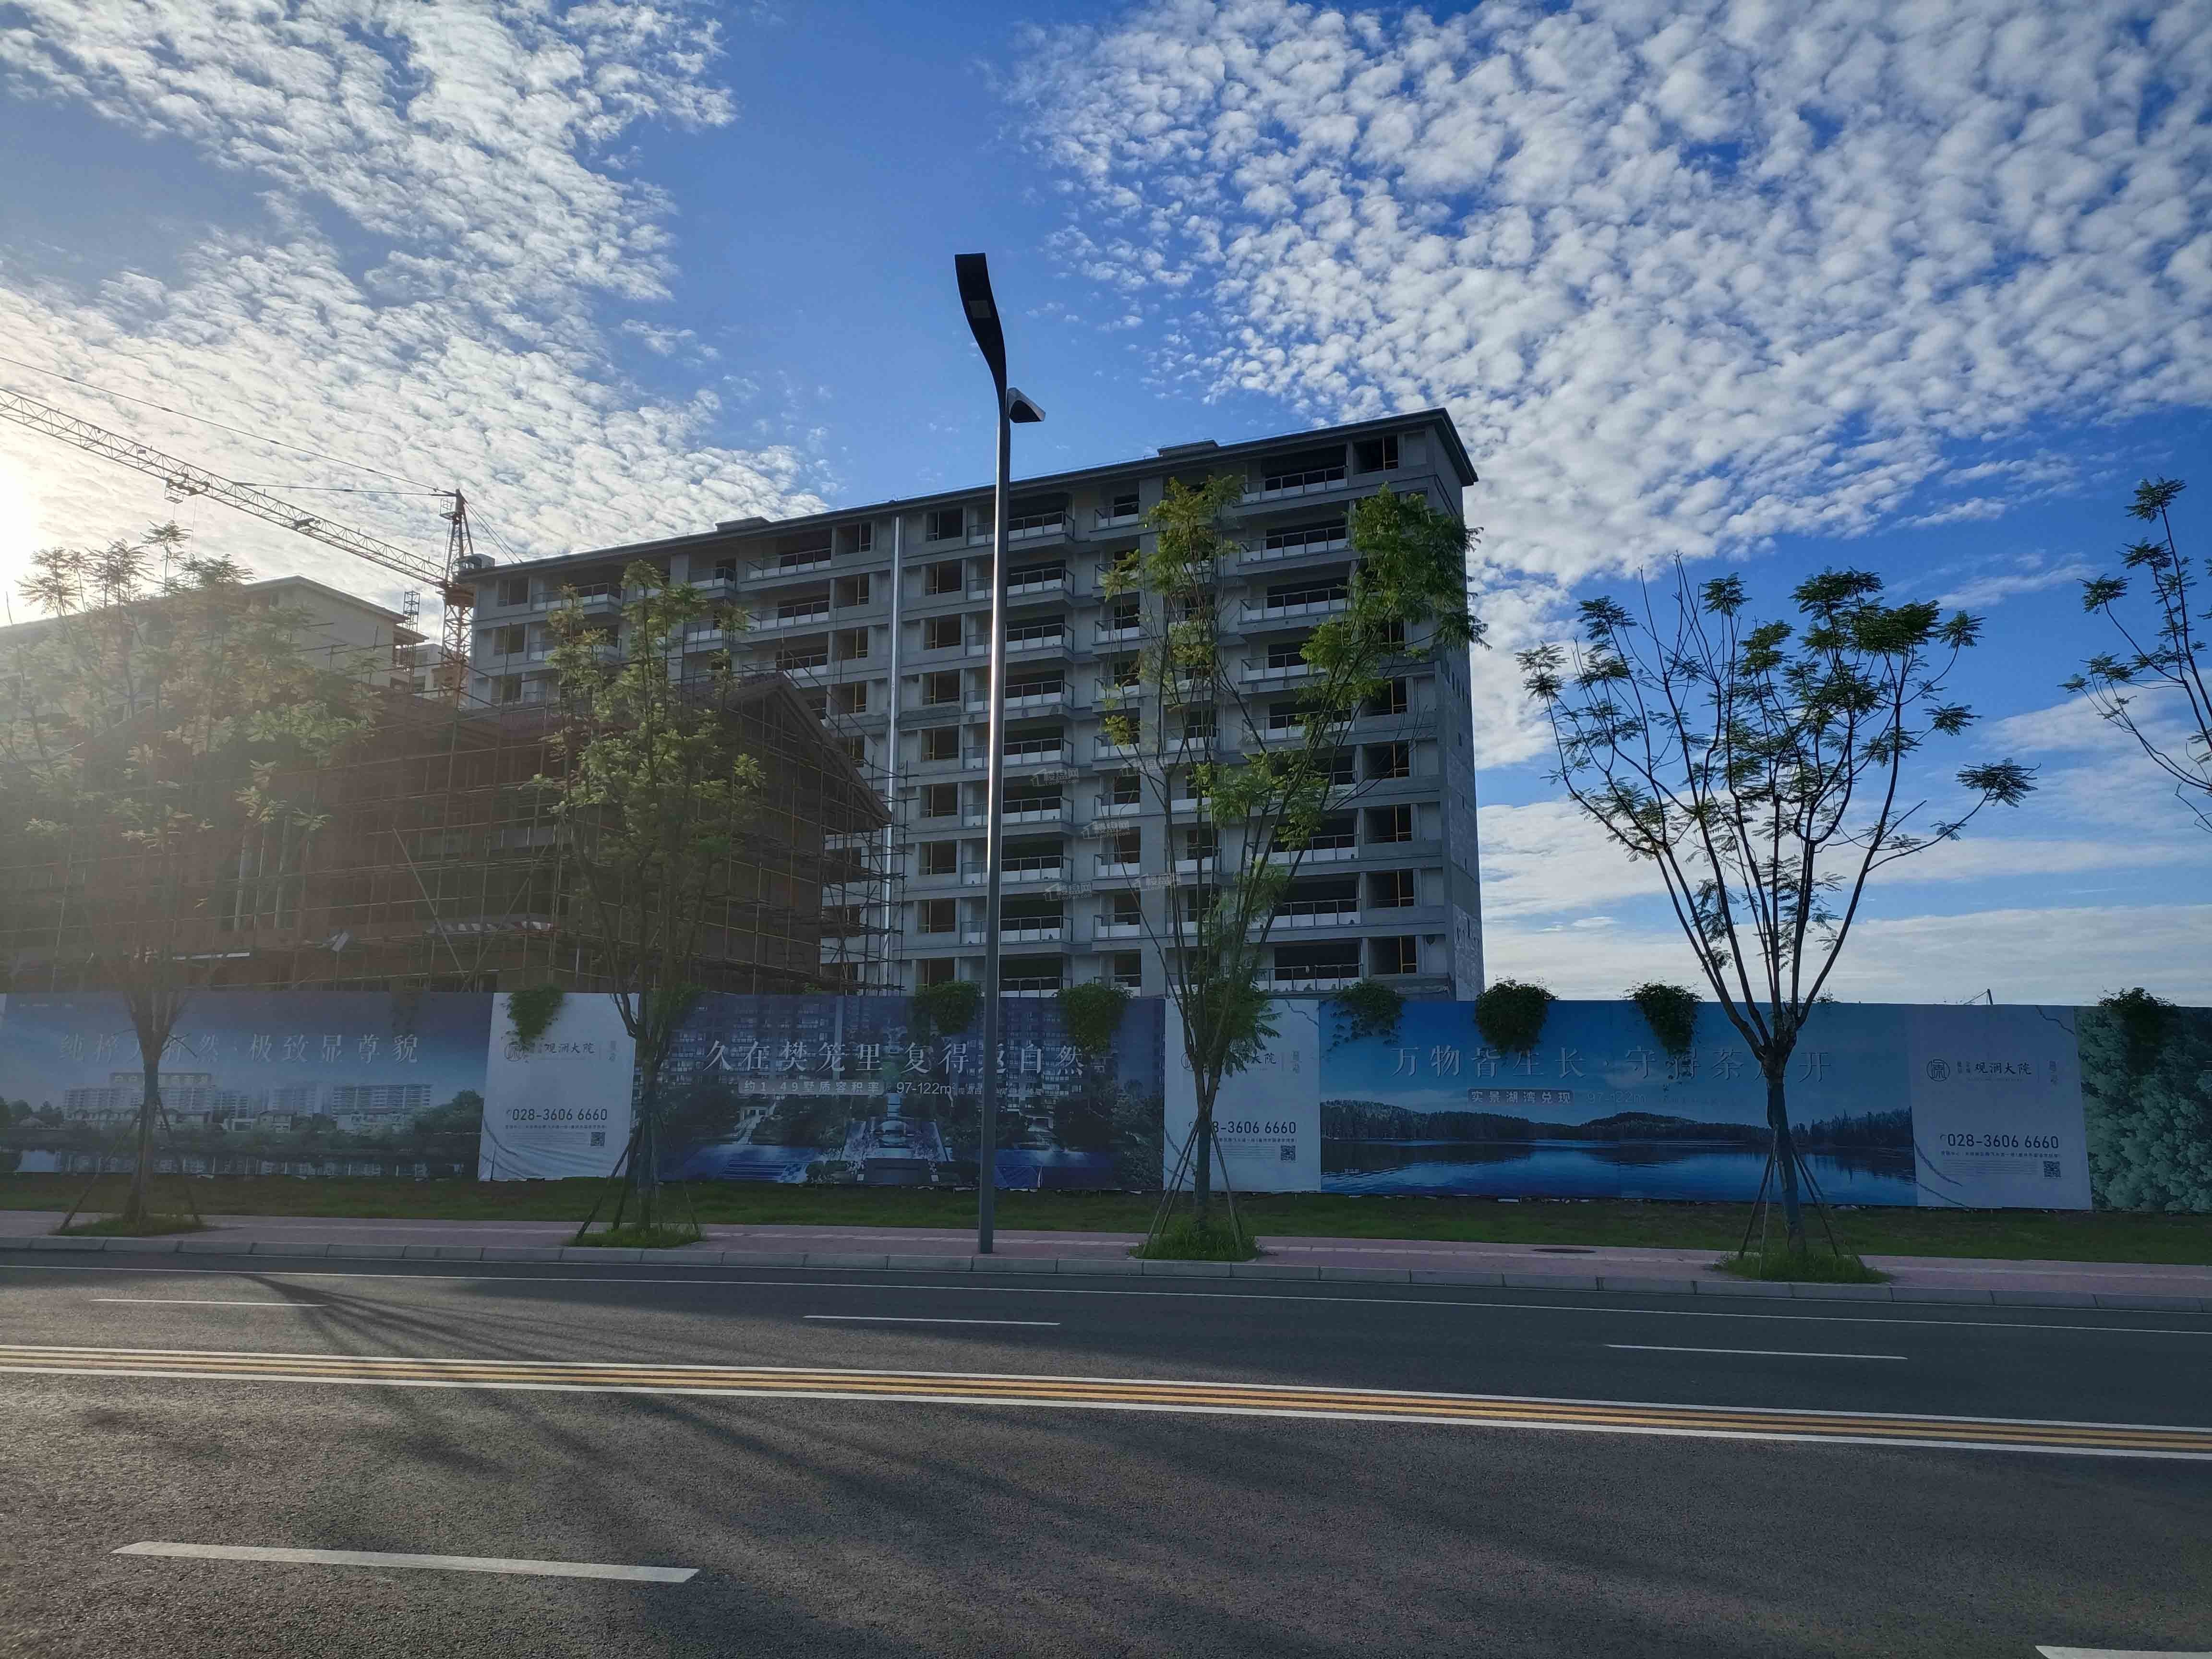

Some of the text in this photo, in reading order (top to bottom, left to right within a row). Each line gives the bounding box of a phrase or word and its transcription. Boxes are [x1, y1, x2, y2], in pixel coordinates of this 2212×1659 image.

[702, 1040, 883, 1072] 久在樊笼里
[1471, 1090, 1571, 1103] 实景湖湾兑现
[512, 1108, 607, 1120] 028-3606 6660
[1264, 1121, 1296, 1134] 6660
[1948, 1133, 2059, 1149] 028-3606 6660
